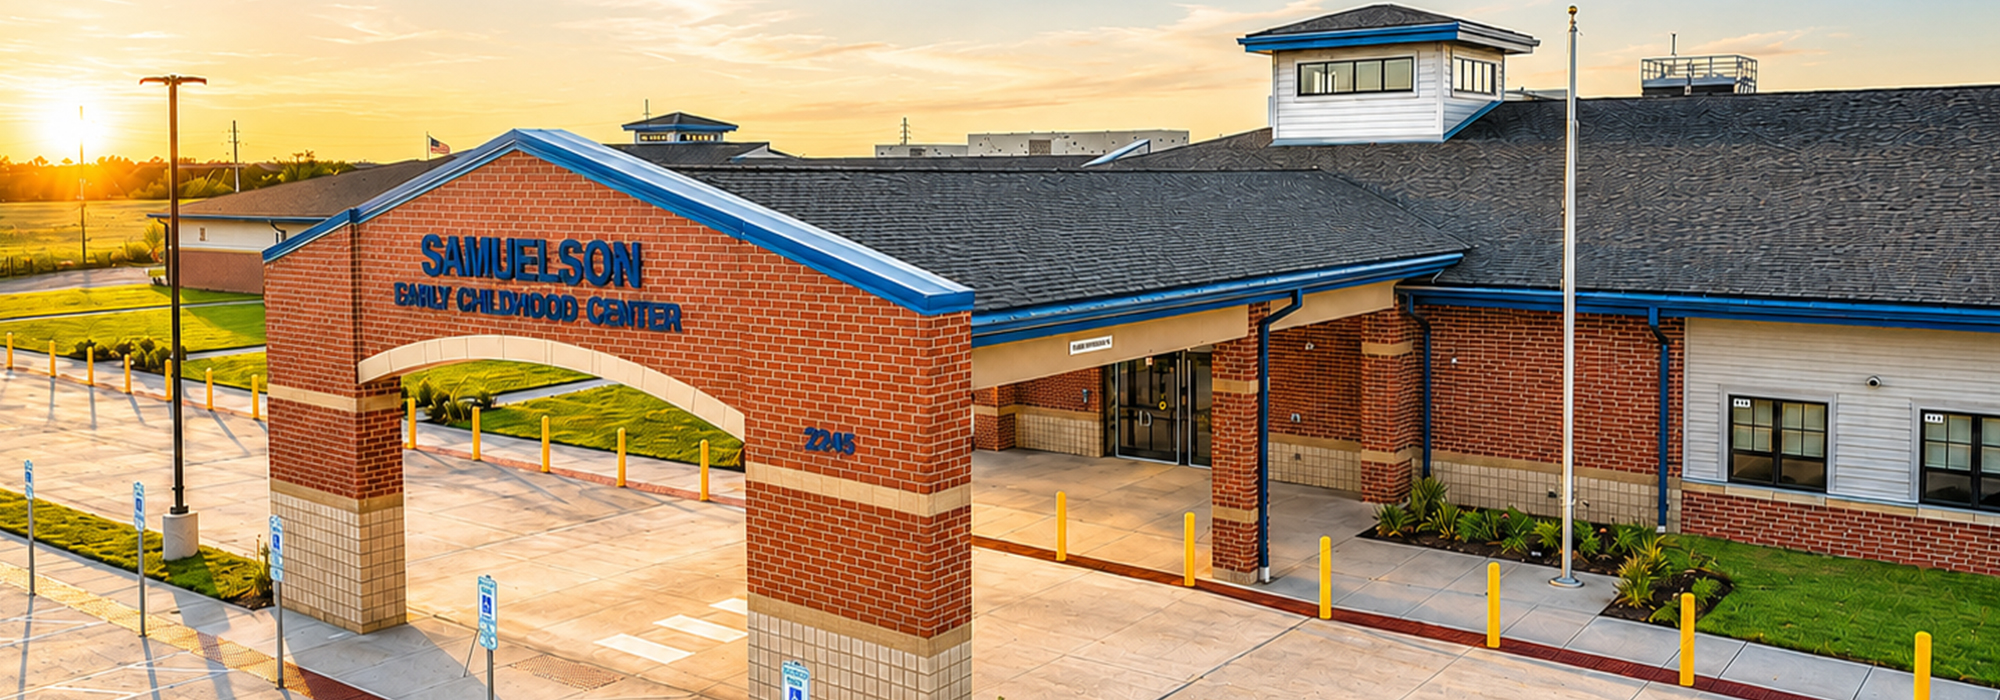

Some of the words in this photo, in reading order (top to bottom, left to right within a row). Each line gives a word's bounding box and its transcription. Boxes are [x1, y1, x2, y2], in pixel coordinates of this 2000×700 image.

[421, 234, 643, 288] SAMUELSON
[456, 287, 579, 322] CHILDHOOD
[586, 296, 682, 332] CENTER
